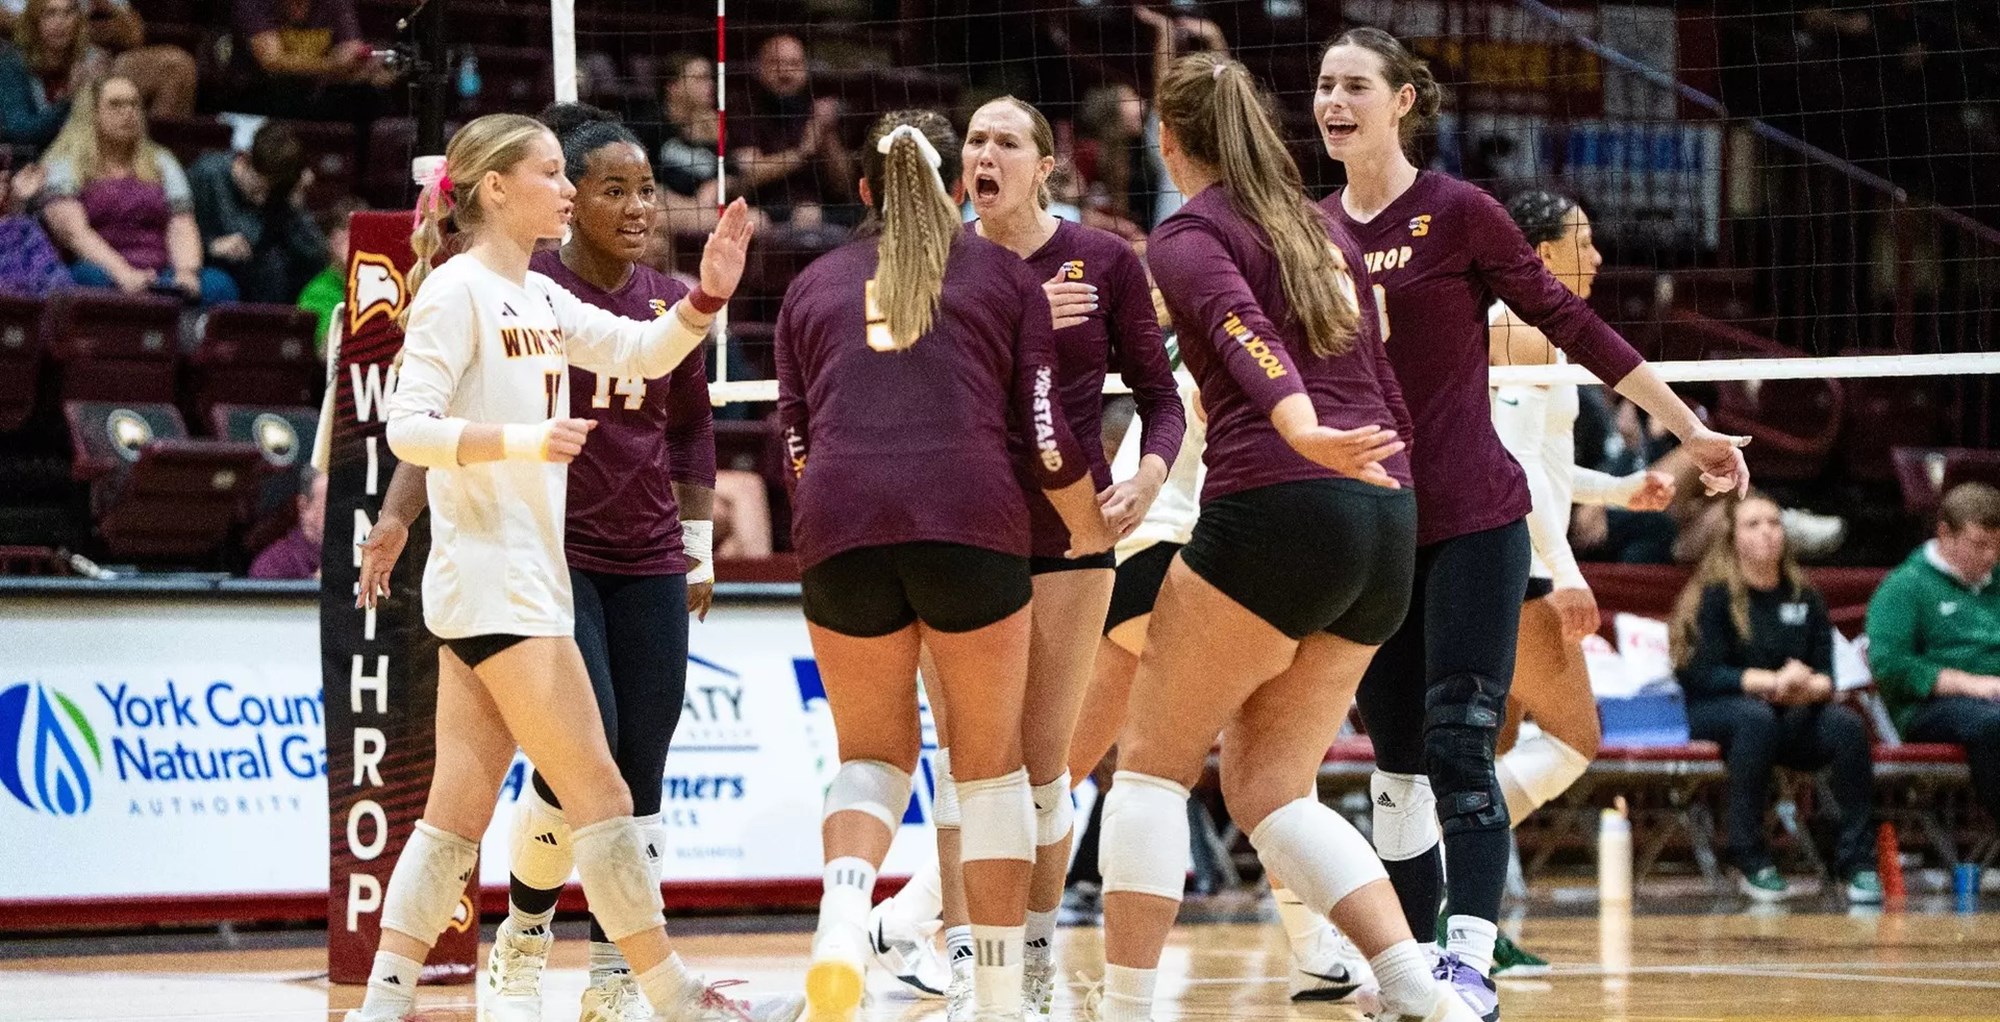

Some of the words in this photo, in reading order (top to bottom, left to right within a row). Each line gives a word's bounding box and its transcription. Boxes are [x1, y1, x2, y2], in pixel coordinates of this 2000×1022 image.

[501, 327, 564, 358] WIN
[592, 372, 647, 410] 14
[96, 680, 198, 727] York
[205, 682, 324, 727] Coun
[112, 733, 271, 781] Natural
[129, 795, 301, 816] AUTHORITY
